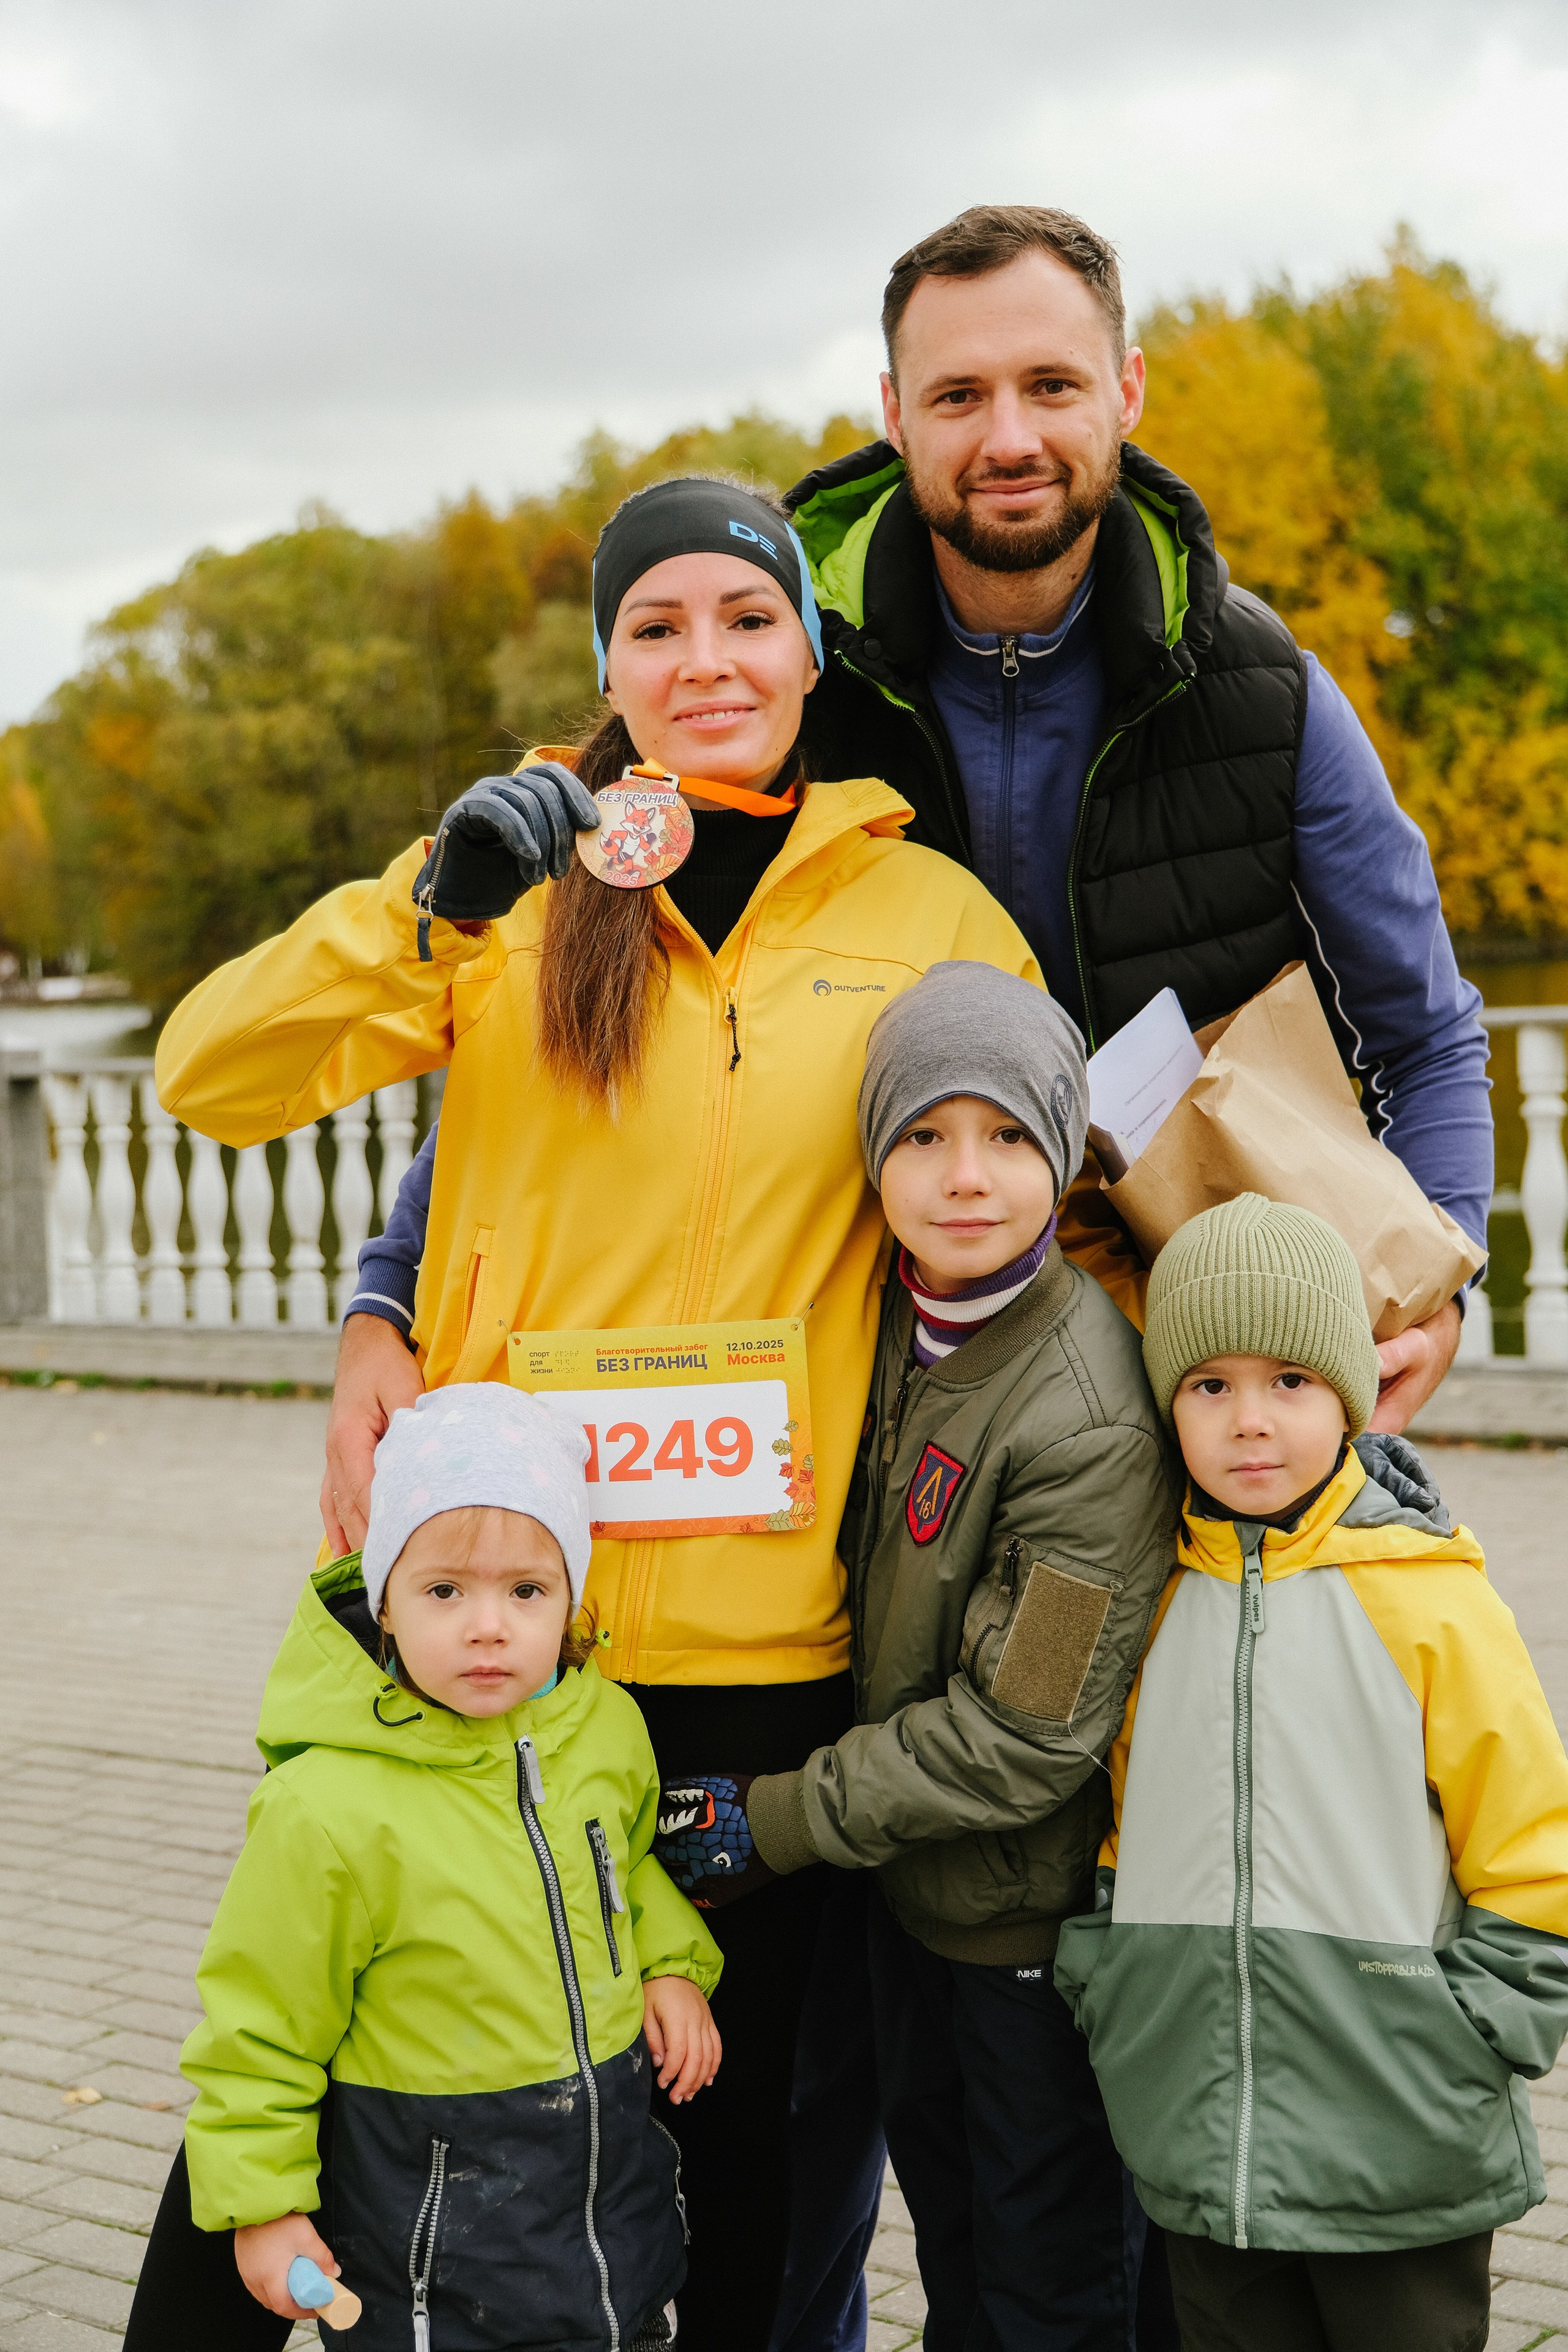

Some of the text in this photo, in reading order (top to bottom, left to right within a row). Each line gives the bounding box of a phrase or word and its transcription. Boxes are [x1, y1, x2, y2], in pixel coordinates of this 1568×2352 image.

[597, 793, 678, 806] БЕЗ ГРАНИЦ
[605, 871, 638, 886] 2025
[596, 1344, 683, 1355] Благотворительный
[726, 1340, 784, 1351] 12.10.2025
[597, 1358, 630, 1373] БЕЗ
[634, 1354, 708, 1371] ГРАНИЦ
[727, 1353, 785, 1366] Москва
[582, 1417, 753, 1483] 1249
